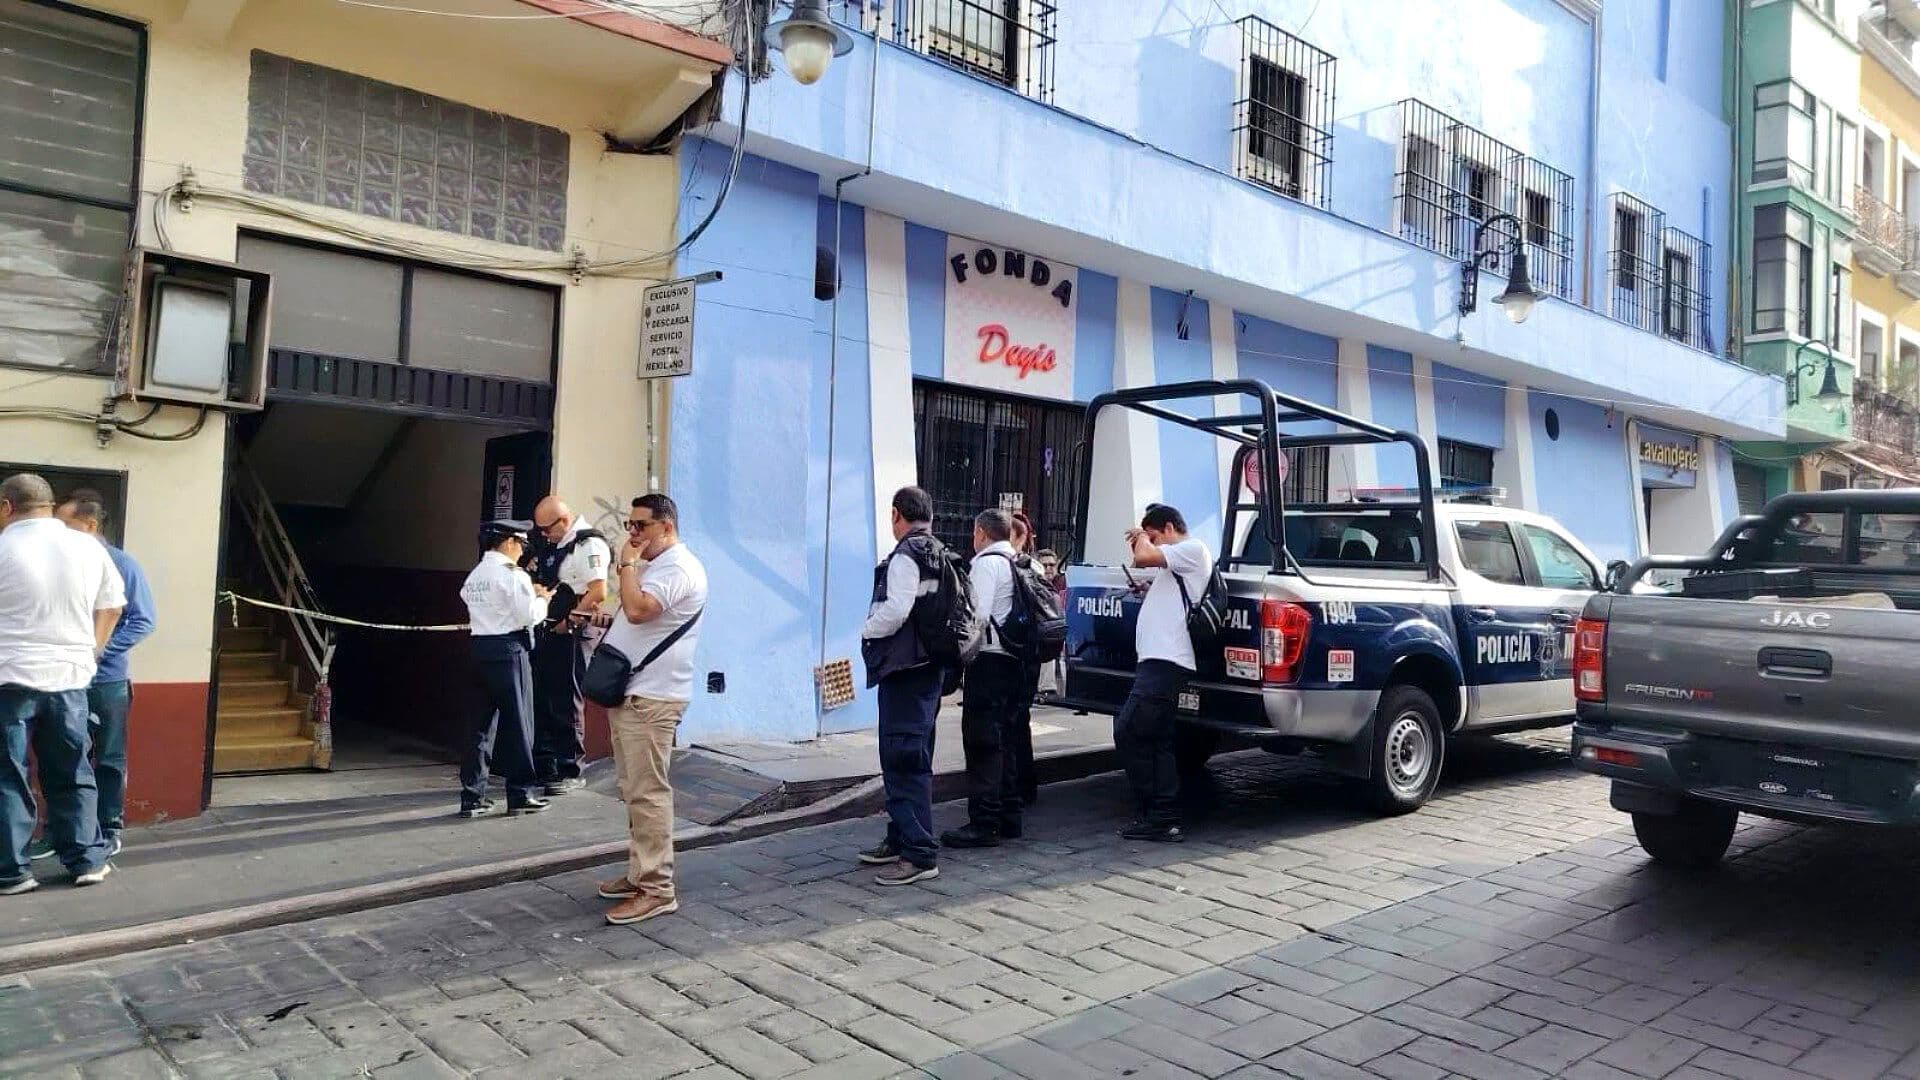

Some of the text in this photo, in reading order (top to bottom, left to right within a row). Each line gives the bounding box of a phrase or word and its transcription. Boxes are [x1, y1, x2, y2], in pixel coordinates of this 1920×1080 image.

[951, 248, 1073, 308] FONDA
[650, 286, 689, 301] EXCLUSIVO
[656, 303, 681, 314] CARGA
[645, 315, 690, 329] Y DESCARGA
[650, 331, 683, 343] SERVICIO
[652, 346, 680, 357] POSTAL
[1221, 608, 1252, 630] PAL
[1319, 601, 1357, 625] 1994
[1760, 610, 1831, 629] JAC
[1227, 650, 1257, 663] 911
